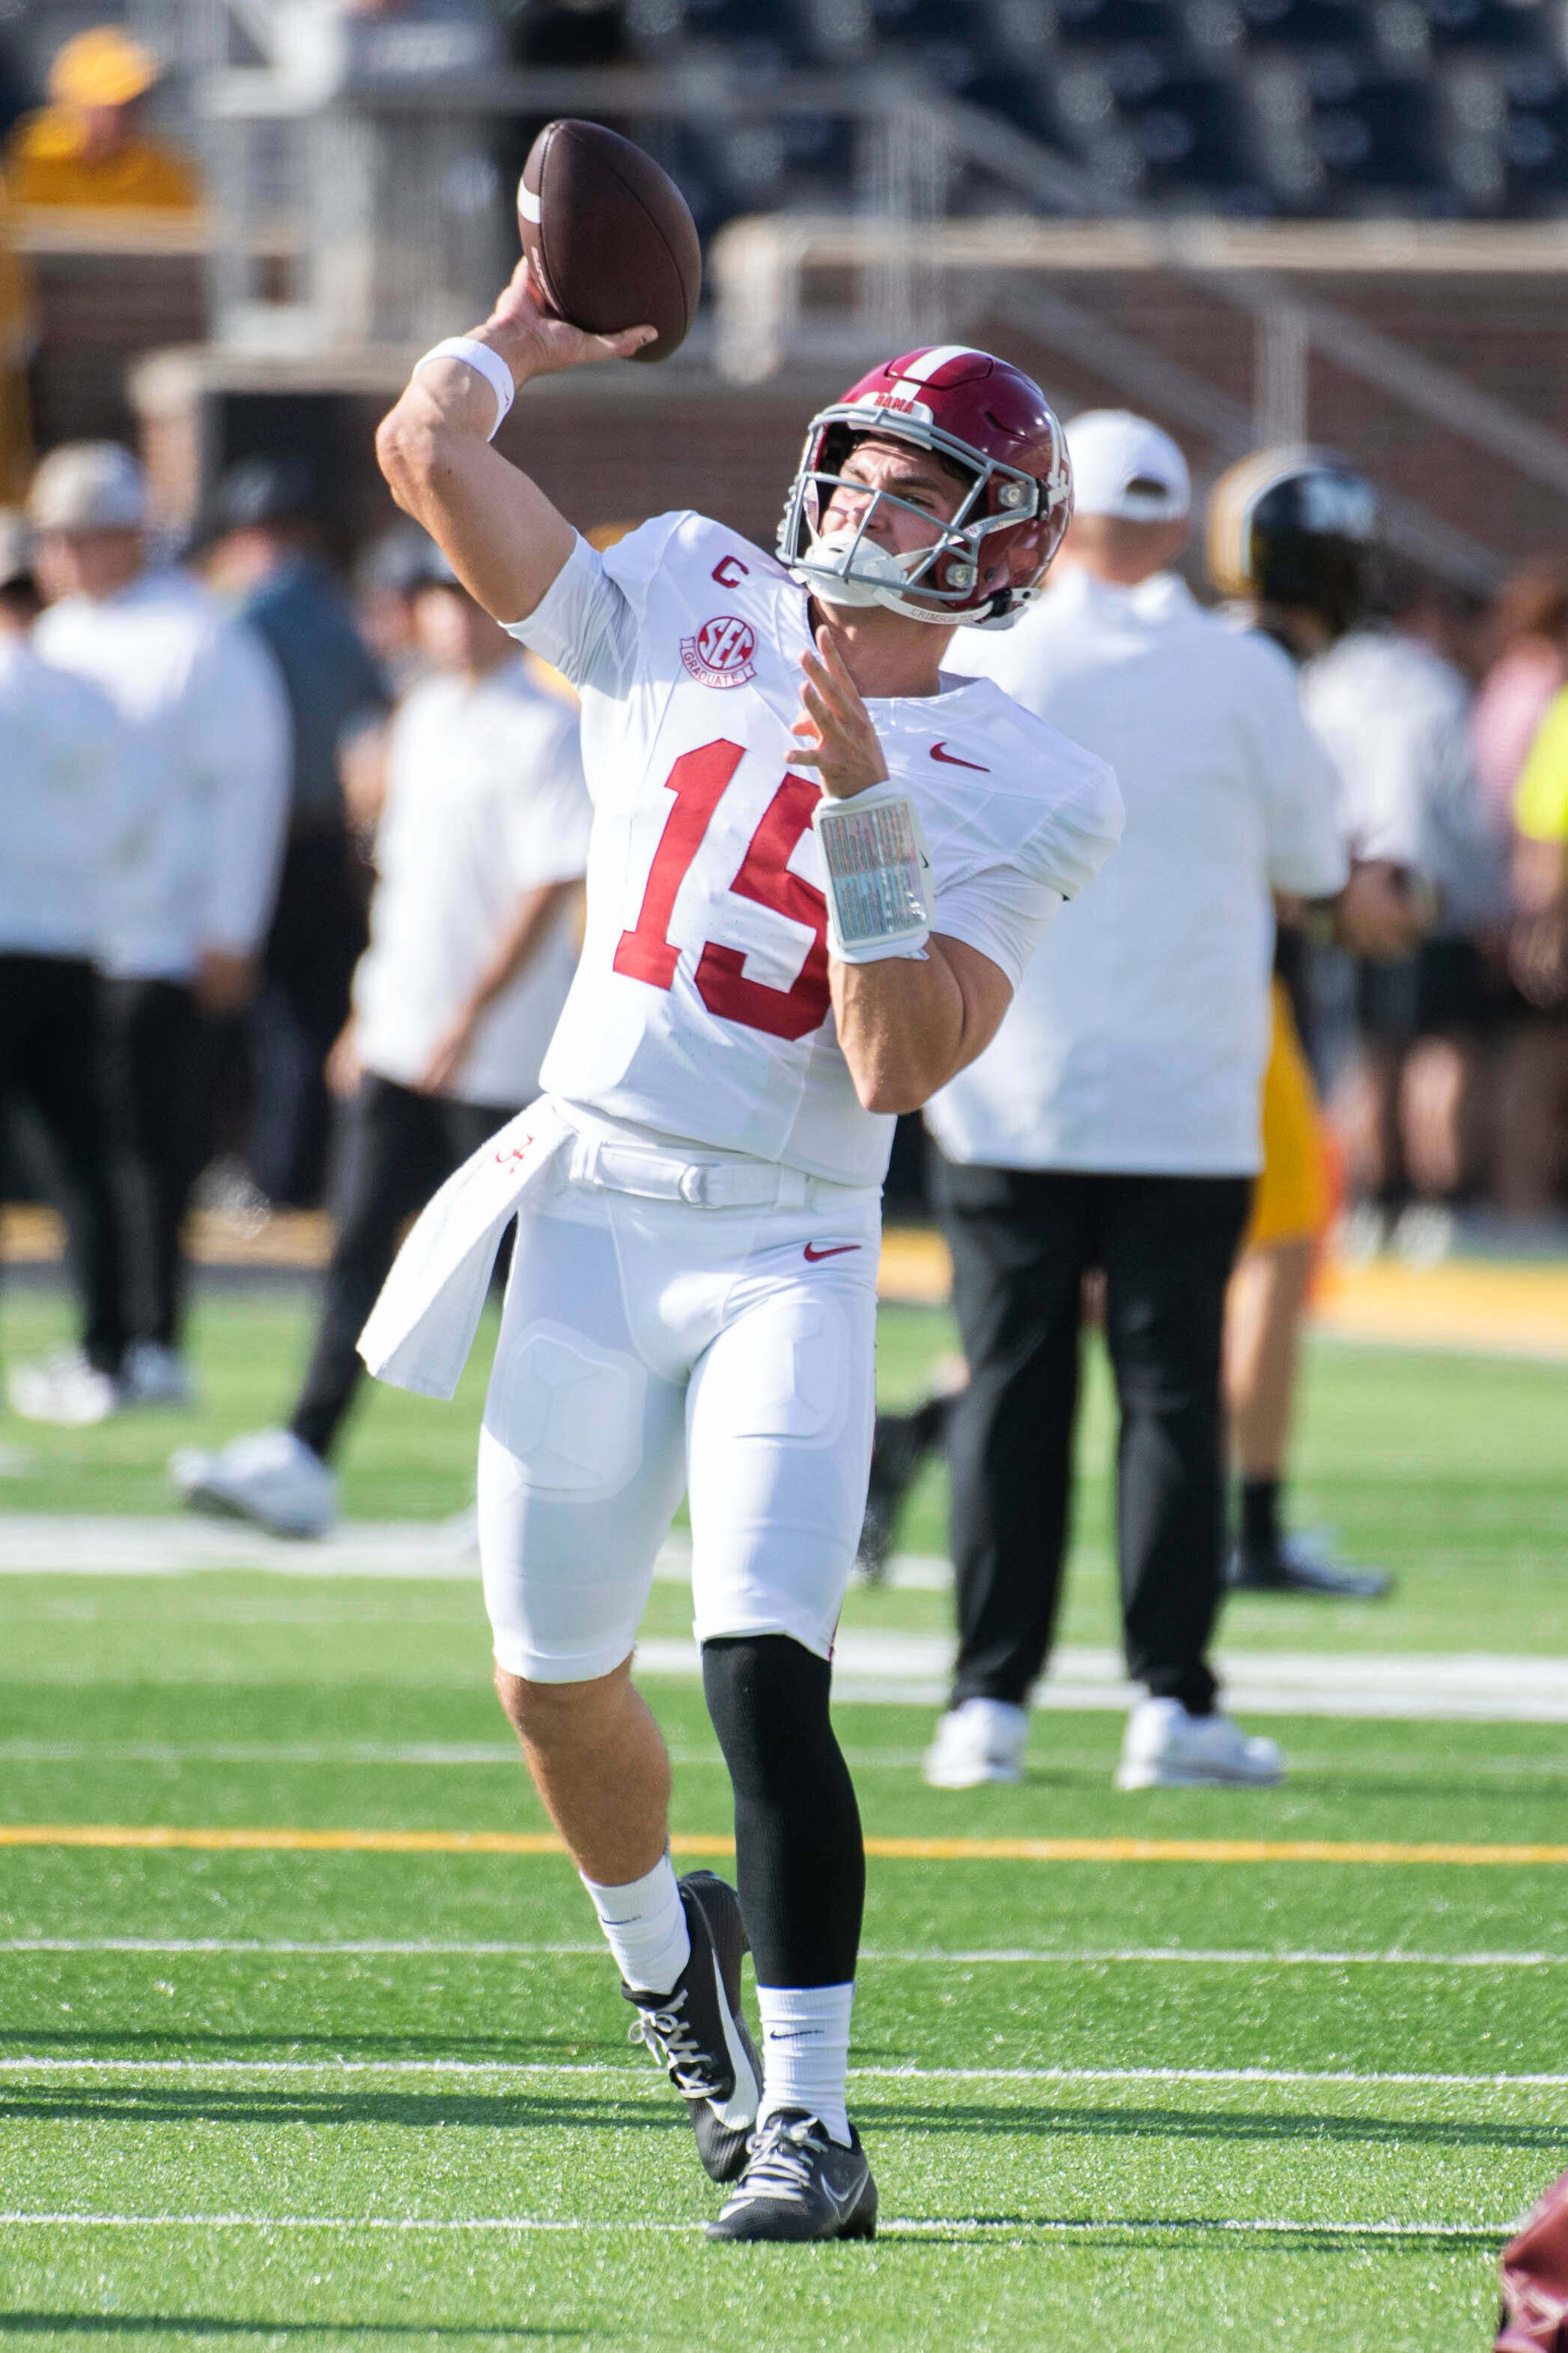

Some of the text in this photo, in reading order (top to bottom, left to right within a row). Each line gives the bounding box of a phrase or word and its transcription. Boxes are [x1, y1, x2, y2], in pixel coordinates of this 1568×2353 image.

[874, 392, 914, 414] BAMA
[712, 555, 750, 589] C
[911, 608, 955, 623] CRIMSON
[699, 617, 755, 670] SEC
[683, 650, 741, 686] GRADUATE
[613, 738, 830, 1041] 15
